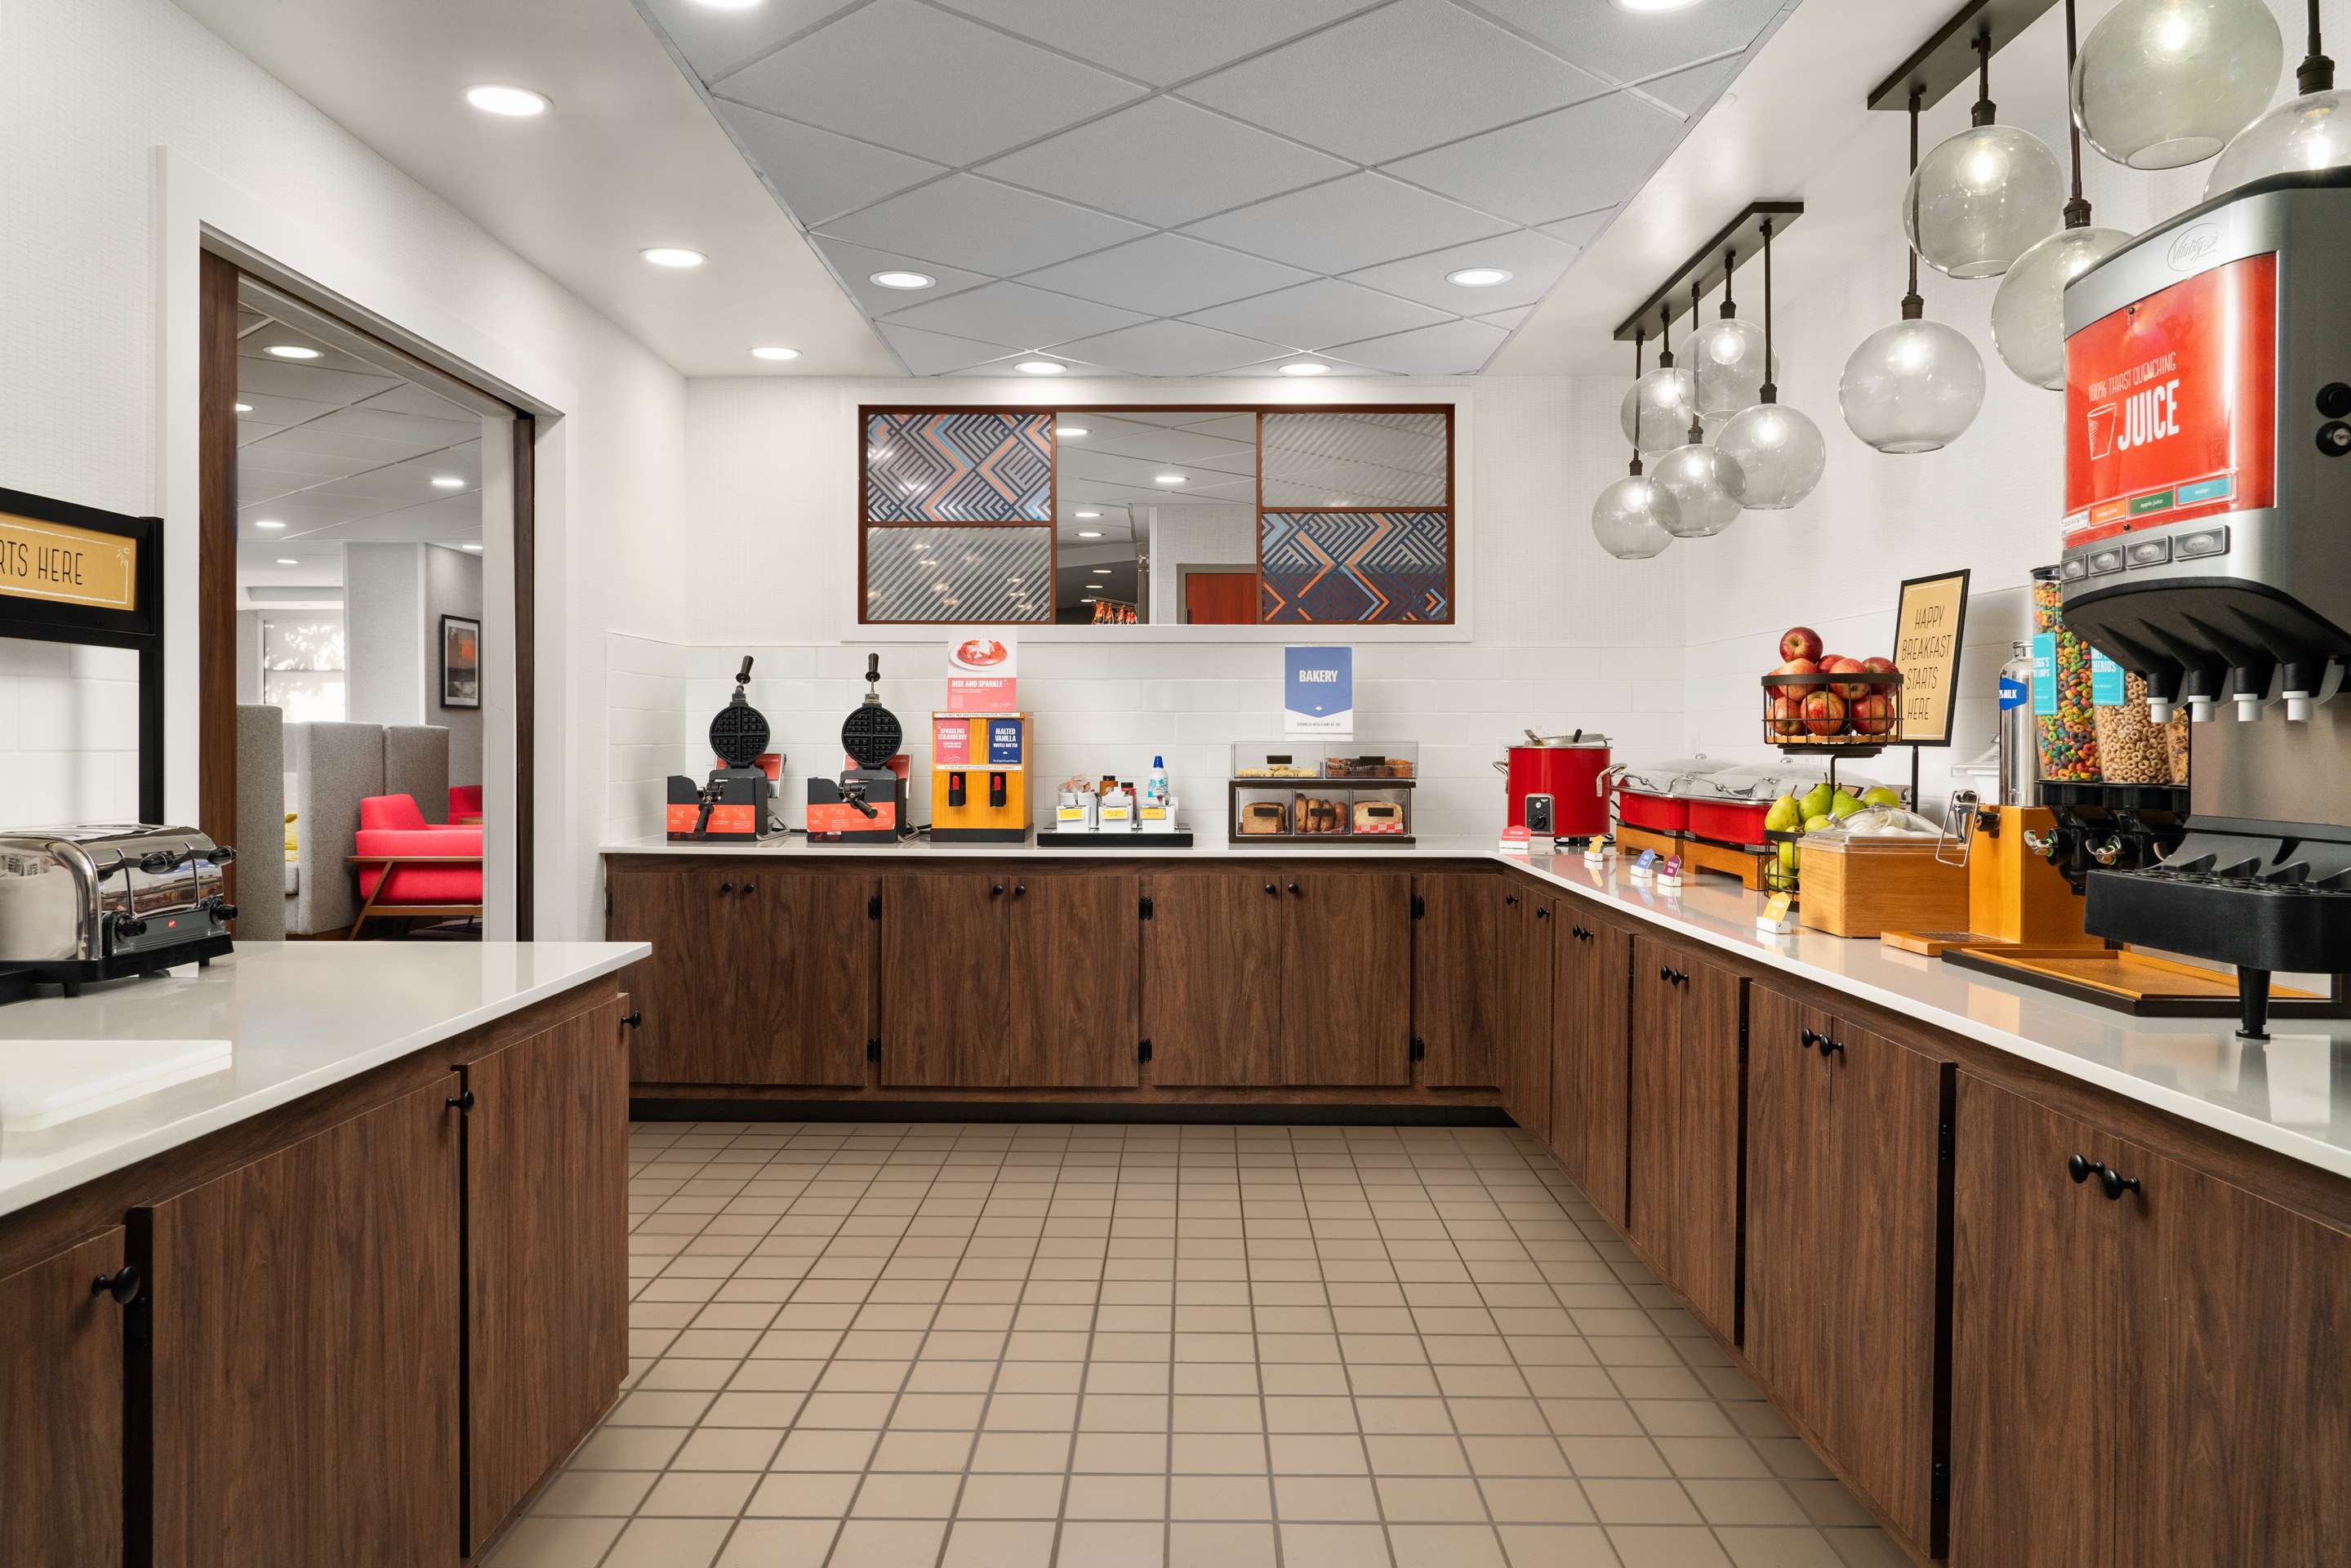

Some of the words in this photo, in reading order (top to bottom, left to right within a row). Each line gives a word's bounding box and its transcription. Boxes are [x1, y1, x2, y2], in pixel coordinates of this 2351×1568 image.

[2088, 381, 2107, 403] 100%
[2108, 369, 2132, 396] THIRST
[2132, 351, 2177, 386] QUENCHING
[2117, 378, 2180, 452] JUICE
[38, 546, 84, 586] HERE
[1914, 605, 1945, 630] HAPPY
[1901, 635, 1952, 661] BREAKFAST
[951, 679, 964, 688] RISE
[965, 679, 977, 688] AND
[978, 679, 1004, 688] SPARKLE
[1299, 670, 1338, 683] BAKERY
[1906, 666, 1939, 690] STARTS
[2004, 688, 2017, 699] MILK
[1907, 697, 1930, 720] HERE
